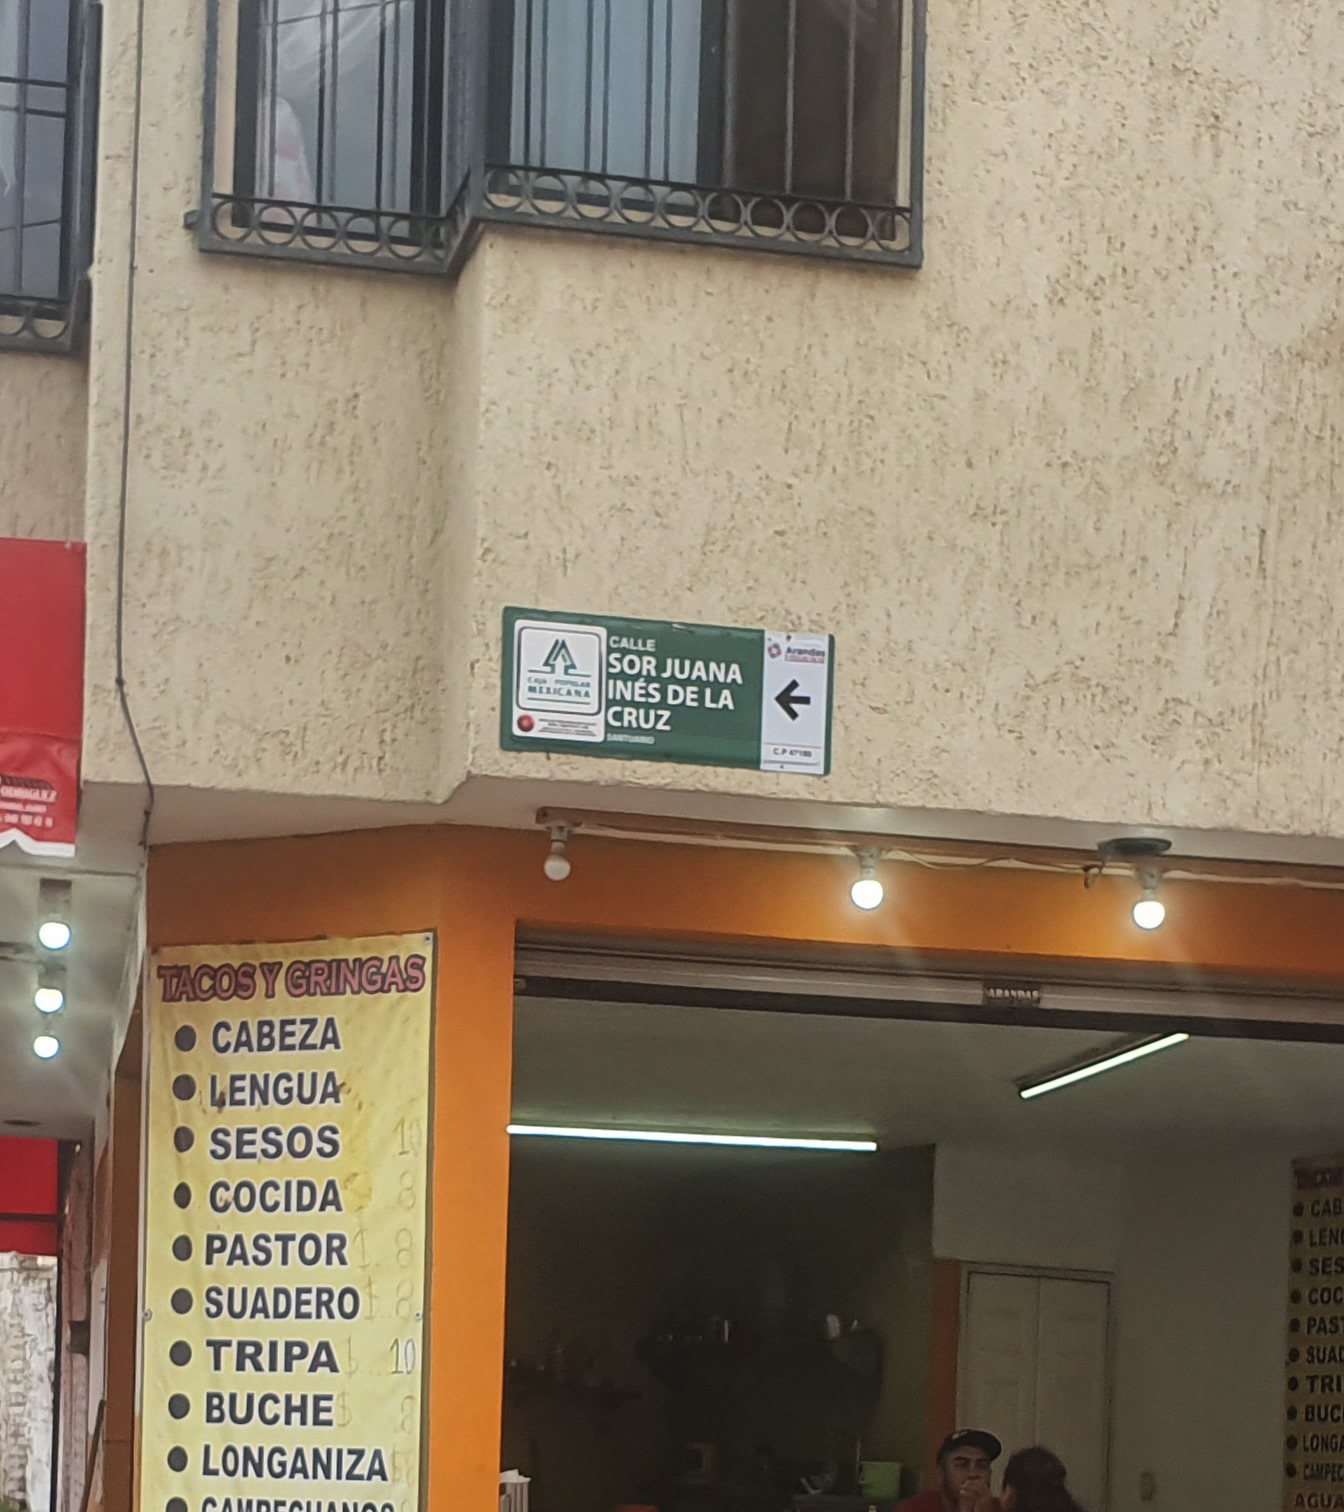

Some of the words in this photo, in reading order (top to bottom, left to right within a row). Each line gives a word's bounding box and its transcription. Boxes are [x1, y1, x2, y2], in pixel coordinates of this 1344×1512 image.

[609, 636, 656, 652] CALLE
[608, 653, 657, 677] SOR
[661, 658, 743, 684] JUANA
[527, 685, 591, 698] MEXICANA
[608, 678, 661, 703] INÉS
[667, 684, 699, 707] DE
[704, 687, 735, 710] LA
[607, 706, 672, 731] CRUZ
[158, 963, 256, 1002] TACOS
[260, 961, 284, 998] Y
[286, 955, 426, 997] GRINGAS
[212, 1017, 341, 1053] CABEZA
[209, 1071, 342, 1107] LENGUA
[209, 1125, 340, 1161] SESOS
[209, 1179, 343, 1213] COCIDA
[204, 1233, 349, 1267] PASTOR
[204, 1286, 360, 1320] SUADERO
[206, 1340, 340, 1374] TRIPA
[390, 1338, 416, 1375] 10
[205, 1393, 334, 1427] BUCHE
[202, 1445, 388, 1481] LONGANIZA
